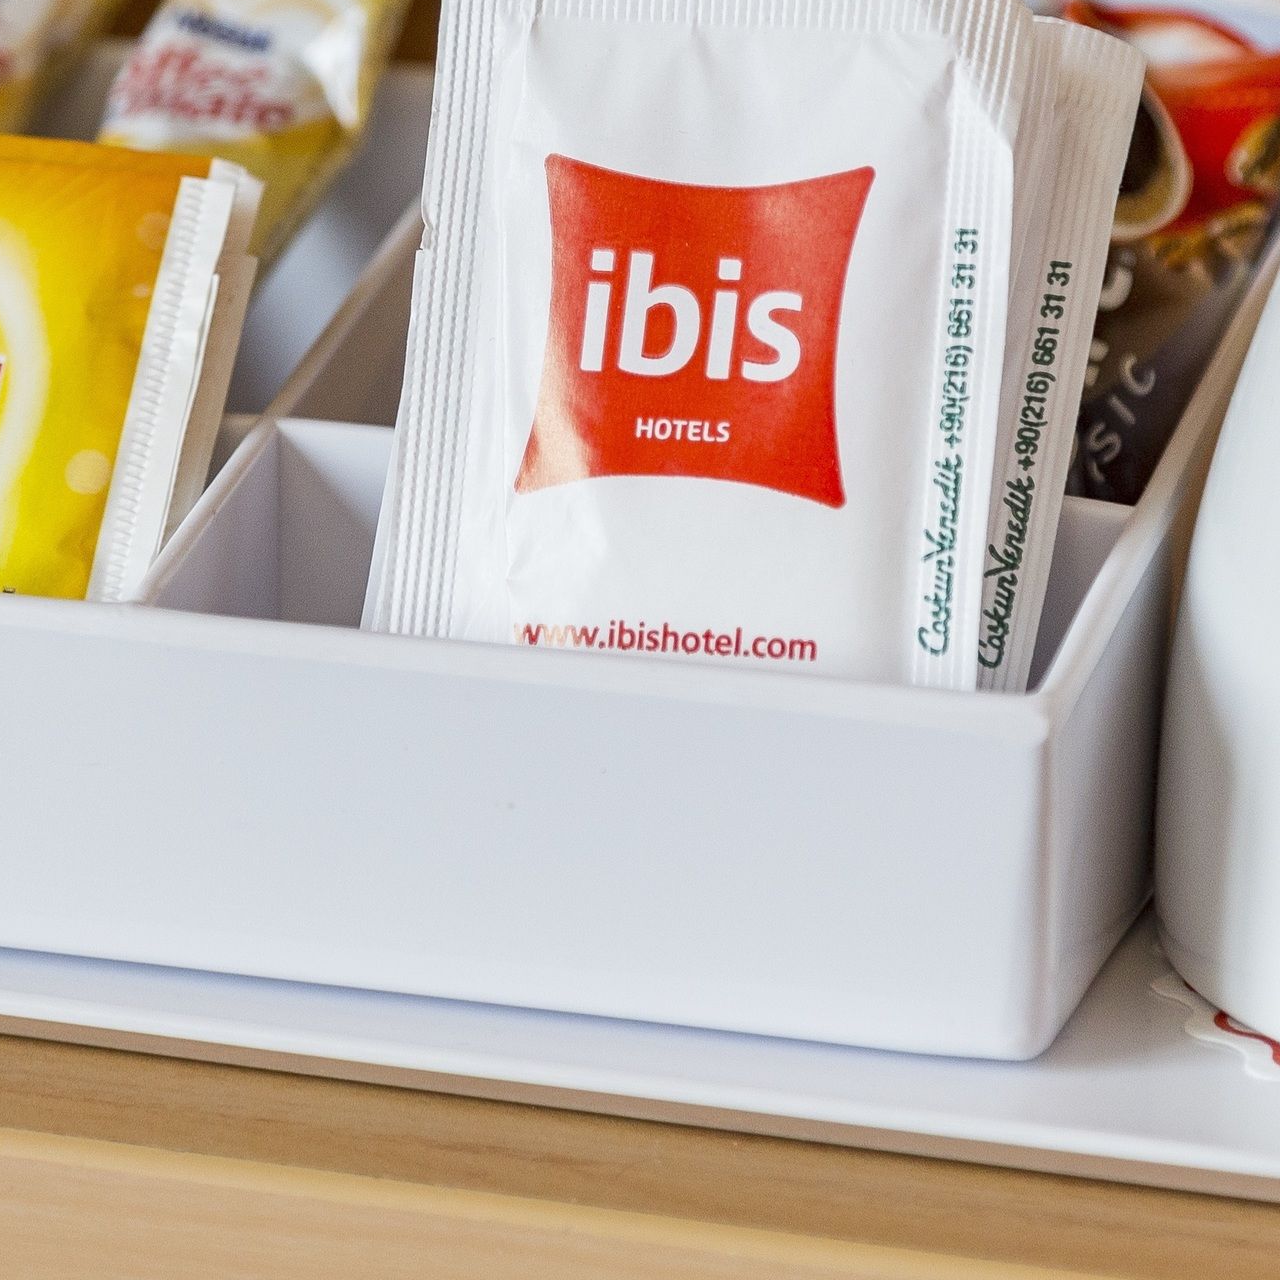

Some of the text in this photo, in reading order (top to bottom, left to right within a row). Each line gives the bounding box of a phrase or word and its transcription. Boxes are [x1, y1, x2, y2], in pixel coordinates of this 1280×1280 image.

[952, 227, 980, 256] 31
[950, 262, 978, 291] 31
[1045, 259, 1074, 288] 31
[579, 248, 804, 383] ibis
[1039, 292, 1068, 321] 31
[1030, 325, 1061, 367] 661
[634, 416, 731, 444] HOTELS
[511, 618, 818, 663] www.ibishotel.com
